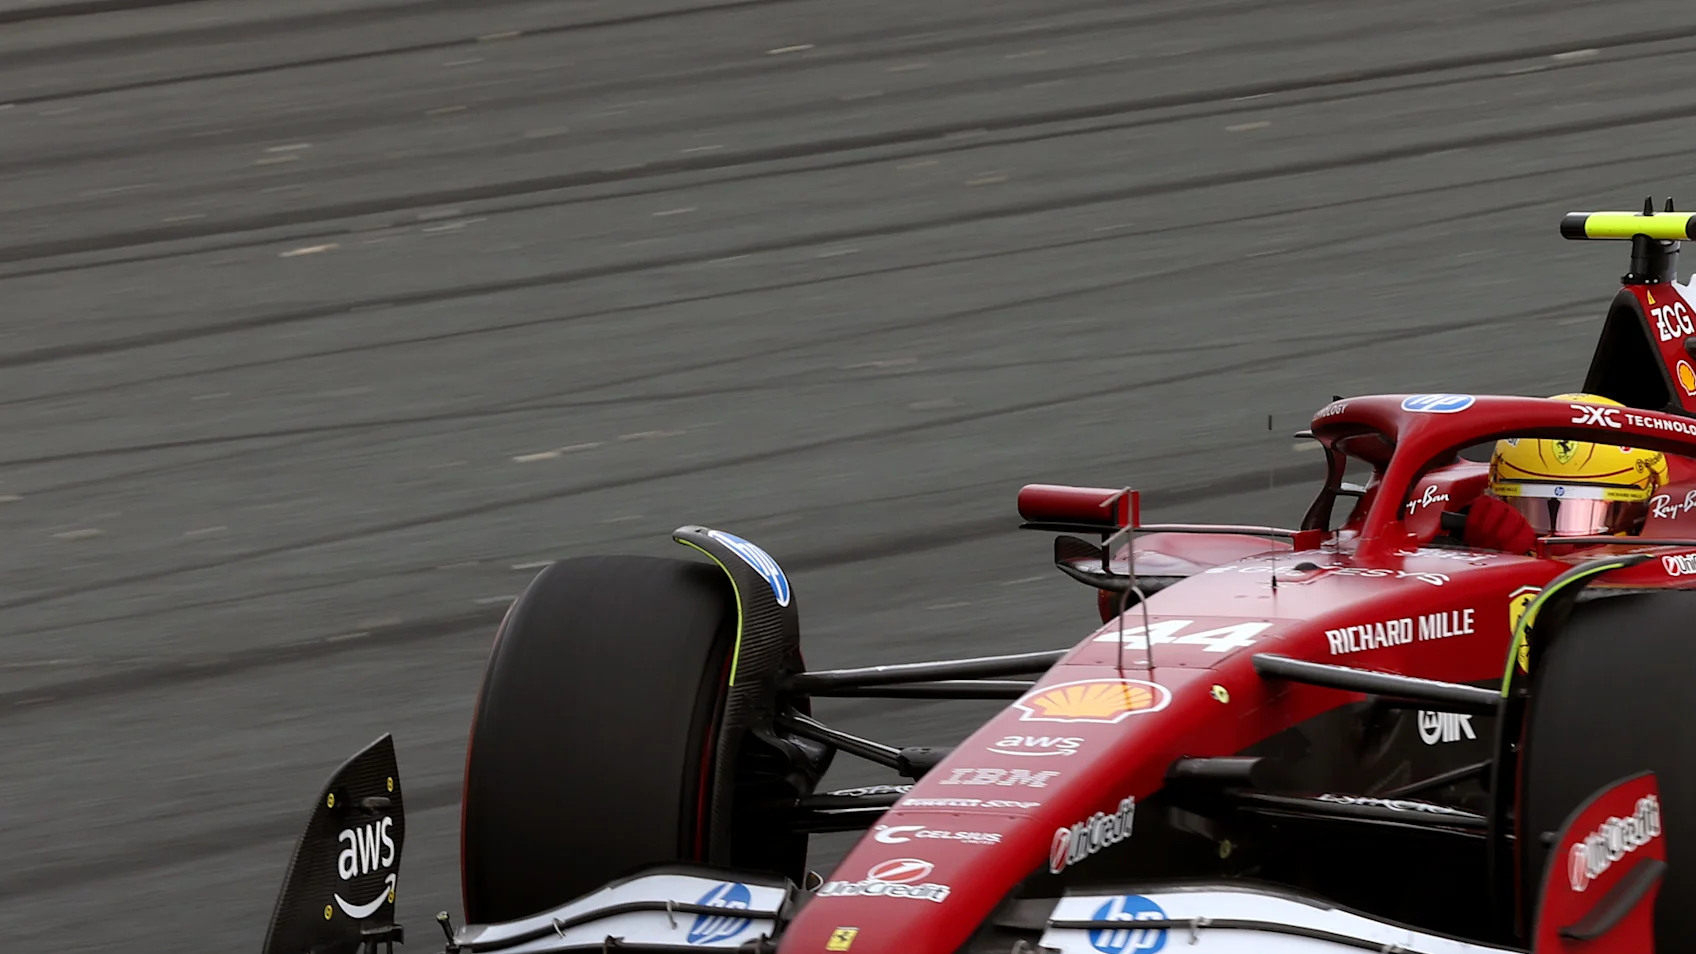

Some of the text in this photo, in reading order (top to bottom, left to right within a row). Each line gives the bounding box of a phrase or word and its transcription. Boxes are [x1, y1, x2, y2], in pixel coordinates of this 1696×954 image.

[1651, 302, 1695, 342] ZCG
[1570, 404, 1622, 429] DXC
[1406, 485, 1450, 514] y-Ban
[1093, 619, 1274, 653] 44
[1325, 608, 1475, 655] RICHARD MILLE
[994, 734, 1084, 750] aws
[939, 768, 1060, 788] IBM
[337, 815, 395, 881] aws
[914, 830, 1003, 844] CELSIUS
[1068, 796, 1135, 867] UniCredit
[1584, 794, 1661, 879] UniCredit
[816, 880, 951, 904] UniCredit
[689, 883, 749, 945] hp
